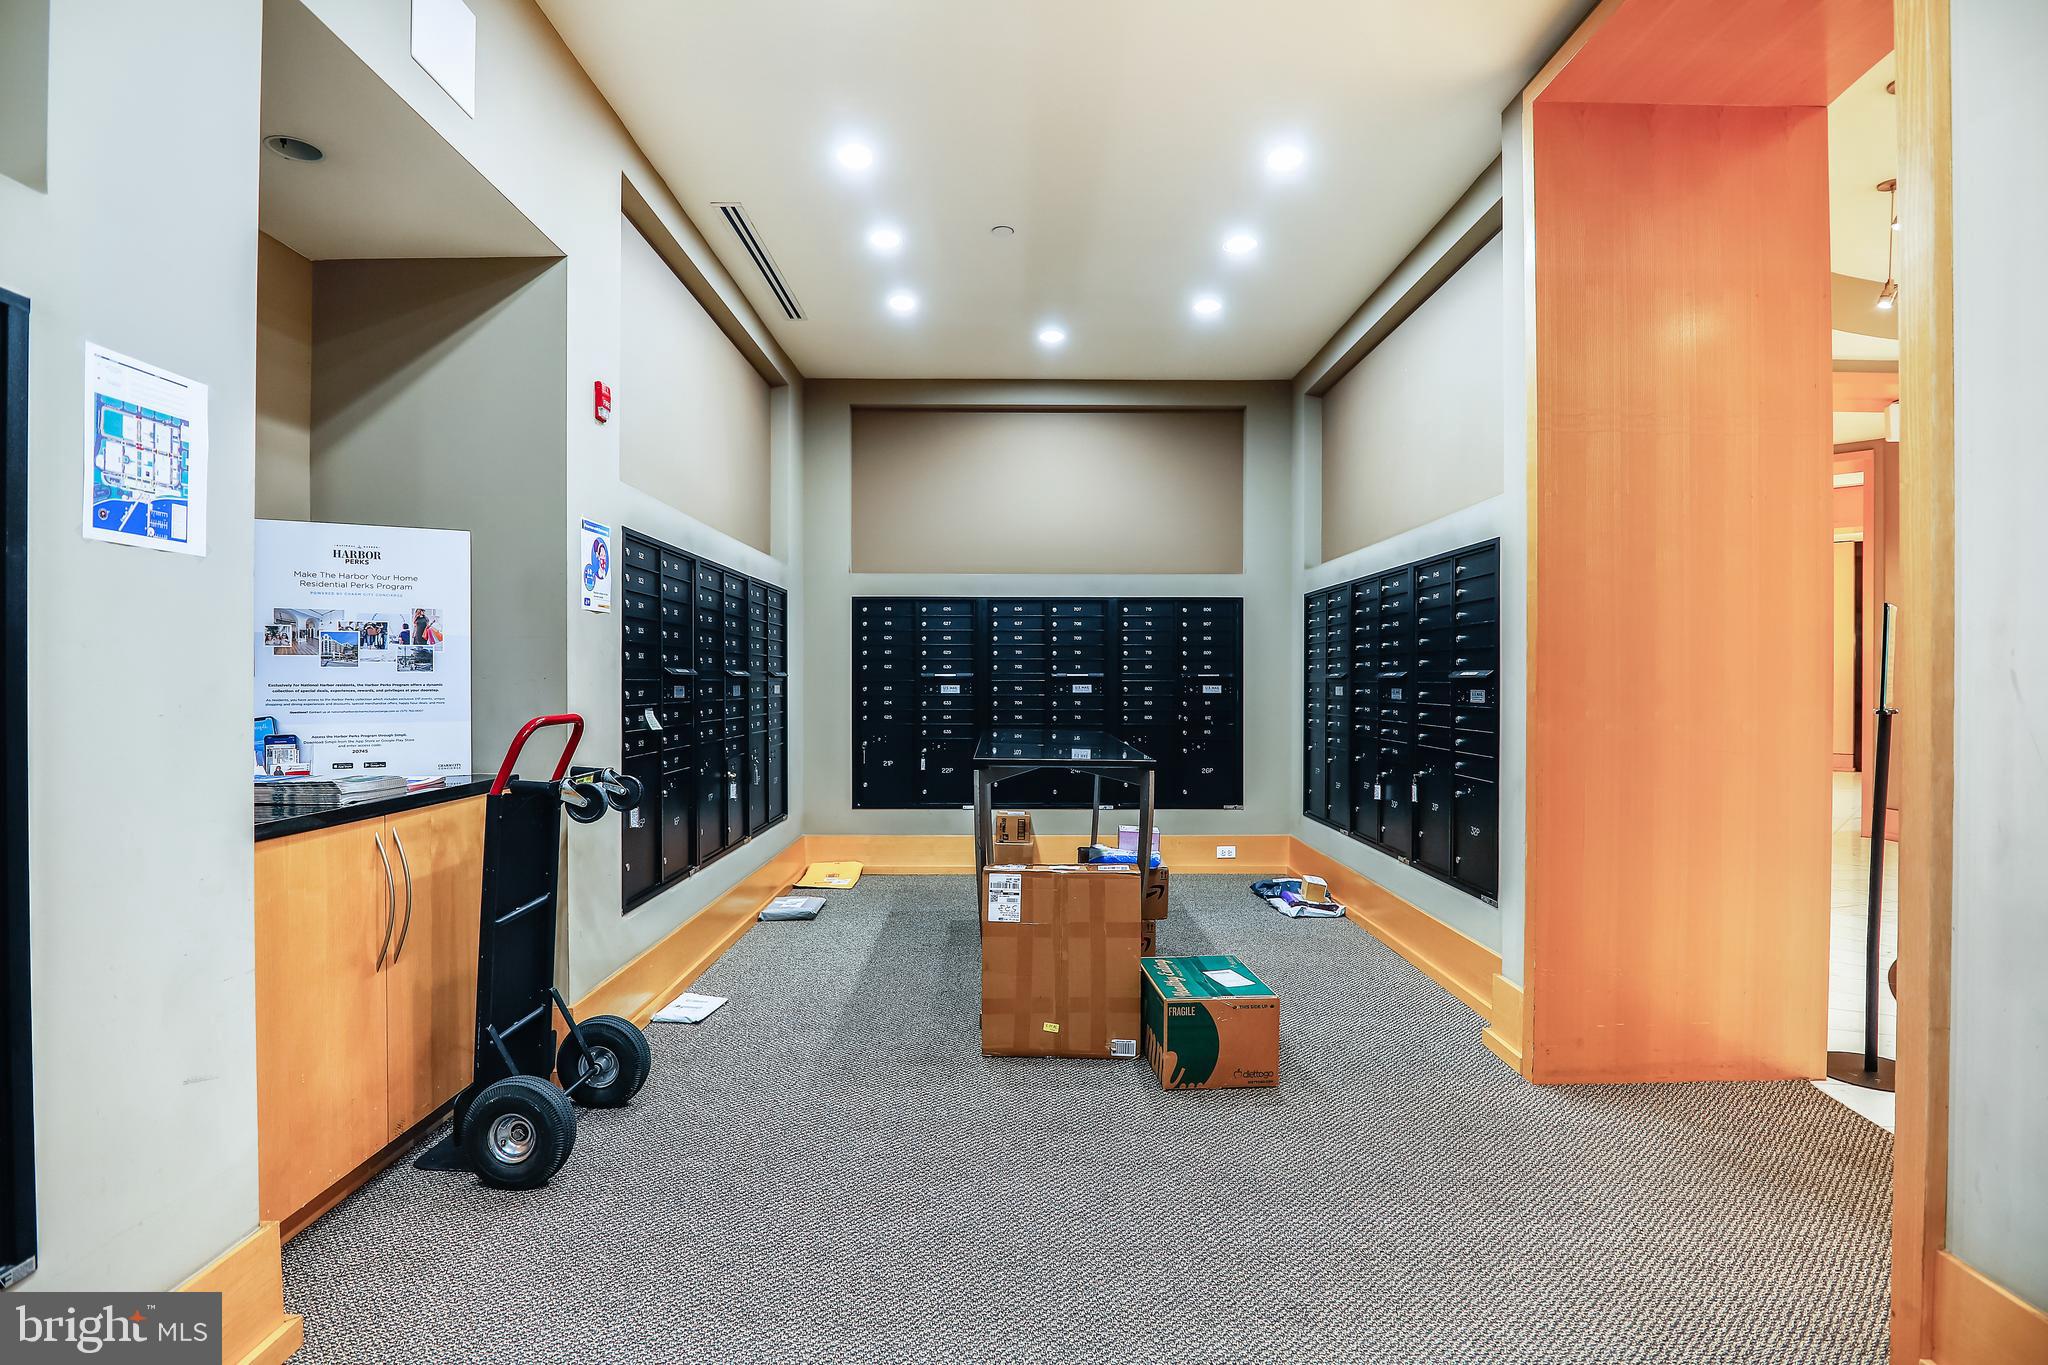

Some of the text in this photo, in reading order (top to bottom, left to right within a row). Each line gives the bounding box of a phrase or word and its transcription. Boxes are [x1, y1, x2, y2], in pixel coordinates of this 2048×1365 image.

[333, 549, 381, 560] HARBOR
[300, 580, 348, 588] Residential
[1168, 1006, 1195, 1016] FRAGILE
